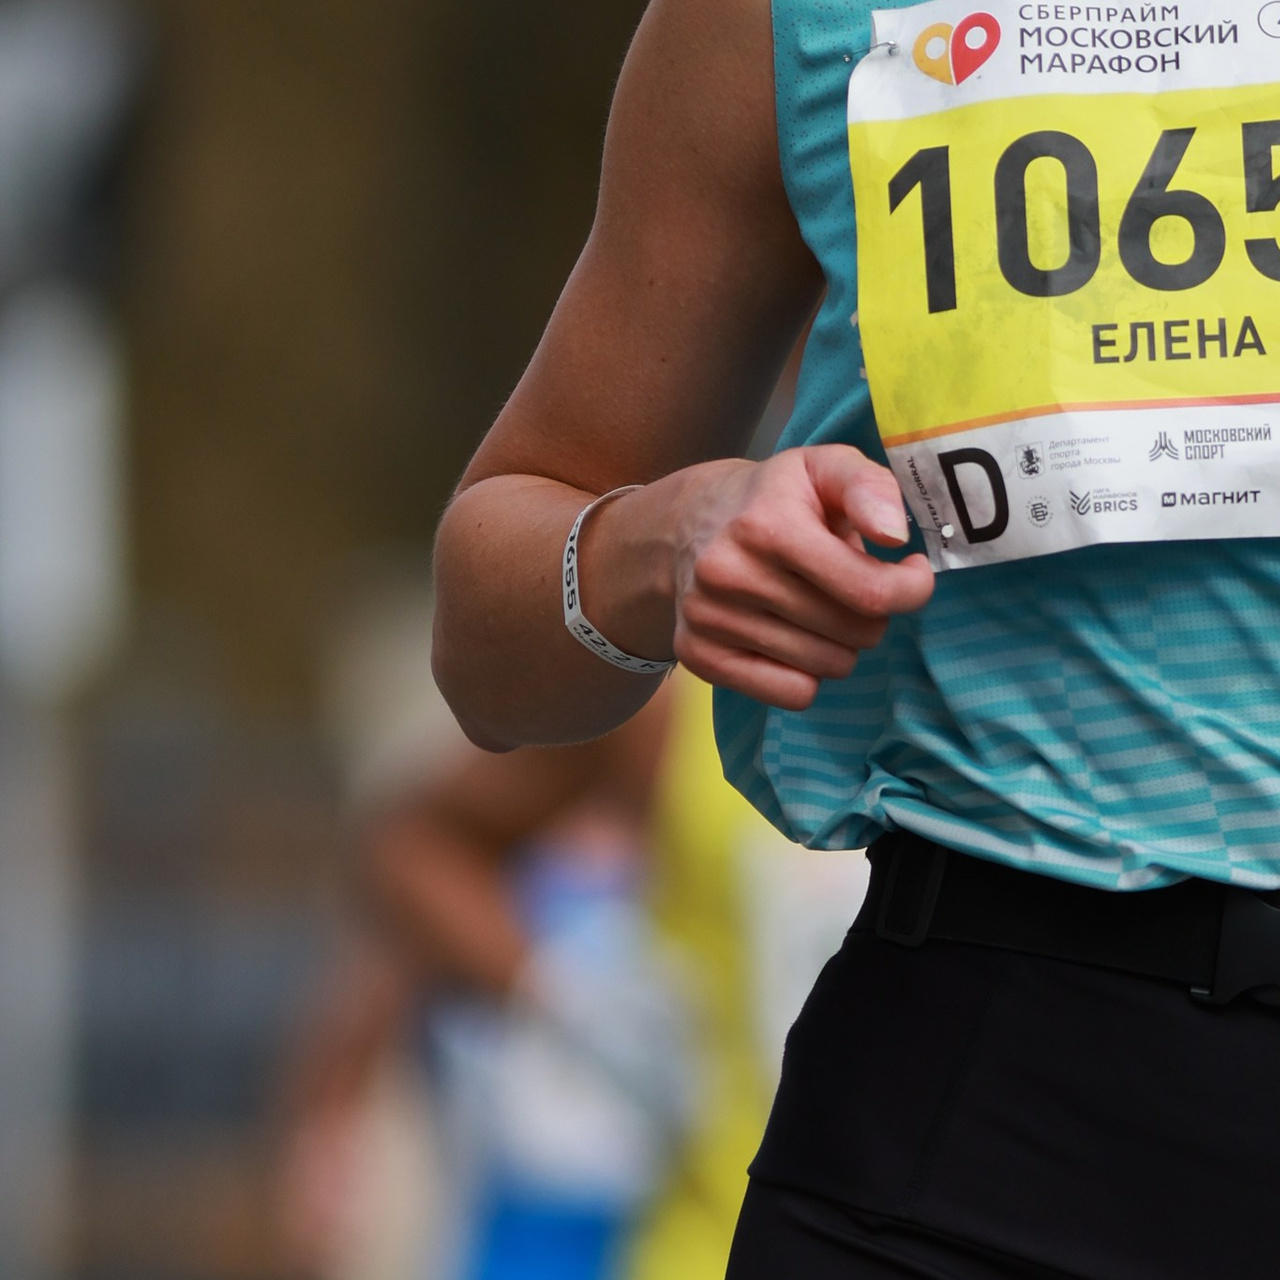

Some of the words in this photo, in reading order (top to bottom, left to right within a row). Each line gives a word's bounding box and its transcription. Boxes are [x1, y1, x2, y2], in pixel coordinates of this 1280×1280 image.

[1018, 2, 1179, 23] СБЕРПРАЙМ
[1019, 19, 1239, 50] МОСКОВСКИЙ
[1019, 51, 1181, 75] МАРАФОН
[1092, 315, 1267, 364] ЕЛЕНА
[1183, 423, 1272, 444] МОСКОВСКИЙ
[1049, 436, 1111, 450] Департамент
[1185, 444, 1226, 460] СПОРТ
[1049, 449, 1081, 461] спорта
[1050, 461, 1082, 472] города
[1084, 457, 1121, 466] Москвы
[937, 447, 1009, 545] D
[1180, 490, 1261, 506] магнит
[1093, 499, 1138, 514] BRICS
